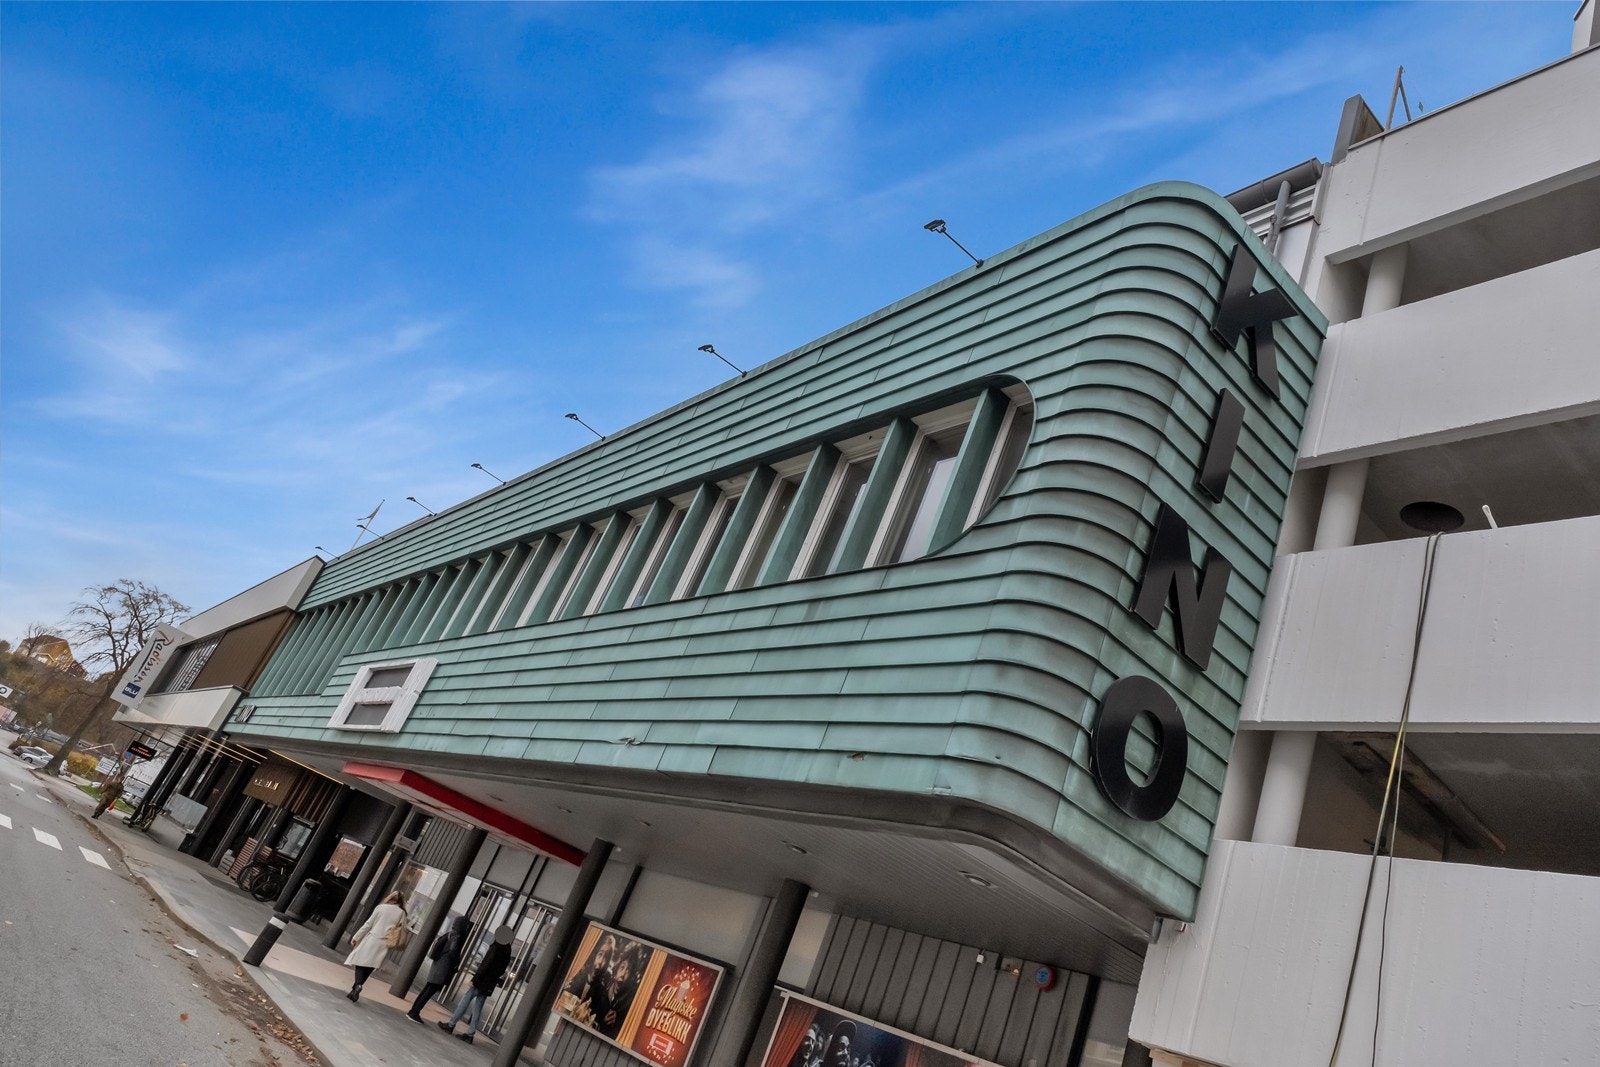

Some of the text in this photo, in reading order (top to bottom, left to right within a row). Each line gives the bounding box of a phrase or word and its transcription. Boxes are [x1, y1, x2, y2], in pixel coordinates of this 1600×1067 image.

[1090, 242, 1299, 823] KINO
[133, 630, 175, 683] Radisson
[655, 984, 697, 1019] Magiske
